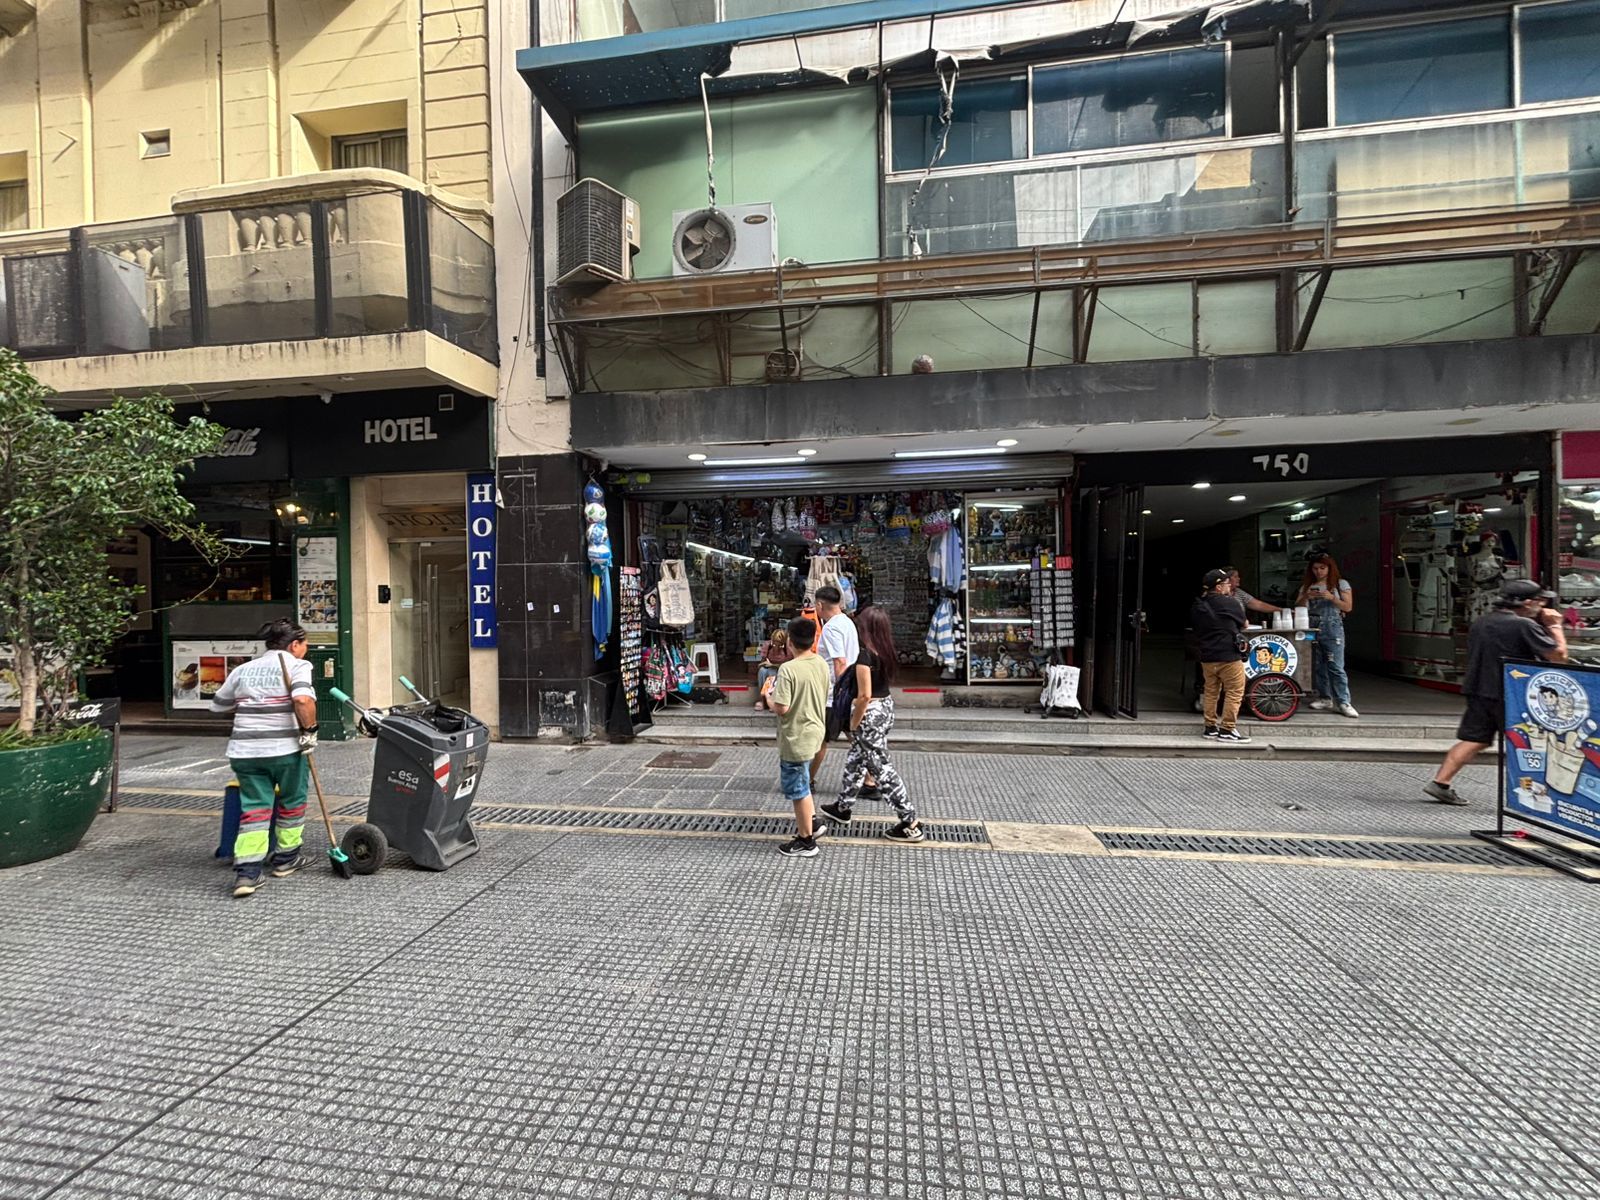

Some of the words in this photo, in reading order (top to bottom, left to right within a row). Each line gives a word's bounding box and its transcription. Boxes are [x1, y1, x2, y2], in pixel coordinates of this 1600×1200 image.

[364, 416, 438, 443] HOTEL
[1252, 452, 1309, 477] 750
[471, 483, 493, 638] HOTEL
[1260, 635, 1290, 649] CHICHA
[1544, 674, 1577, 694] CHICHA
